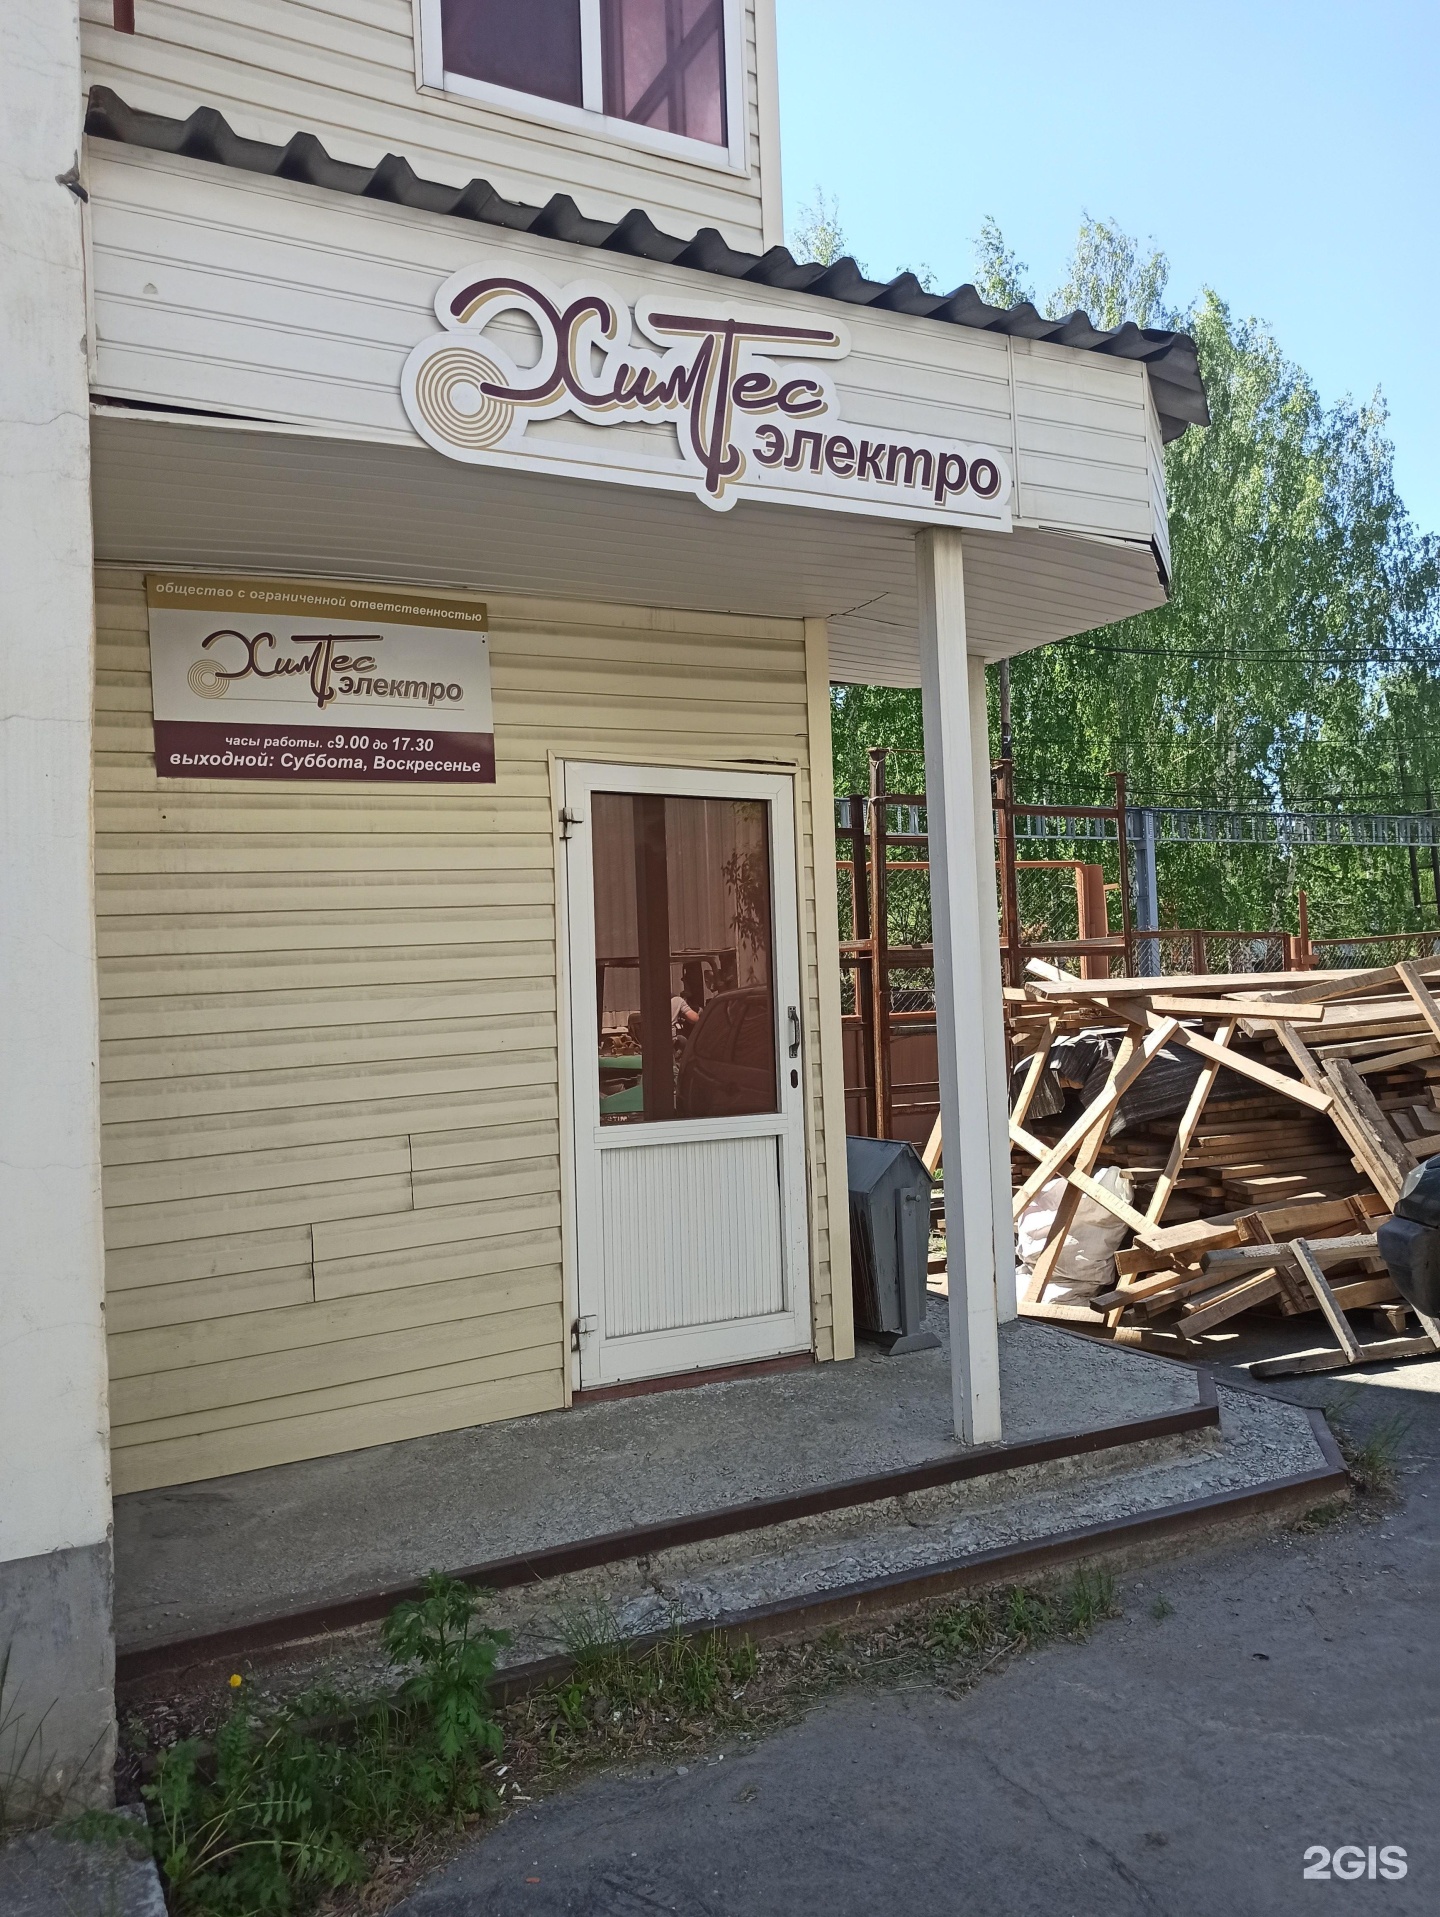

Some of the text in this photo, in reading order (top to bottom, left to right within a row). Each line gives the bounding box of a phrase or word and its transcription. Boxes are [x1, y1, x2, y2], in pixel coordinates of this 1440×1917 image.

[752, 424, 1001, 504] электро
[156, 582, 482, 622] общество с ограниченной ответственностью
[338, 675, 464, 706] электро
[225, 737, 261, 746] часы
[263, 736, 323, 748] работы.
[372, 739, 388, 750] до
[392, 736, 434, 752] 17.30
[169, 750, 481, 774] выходной: Суббота, Воскресенье
